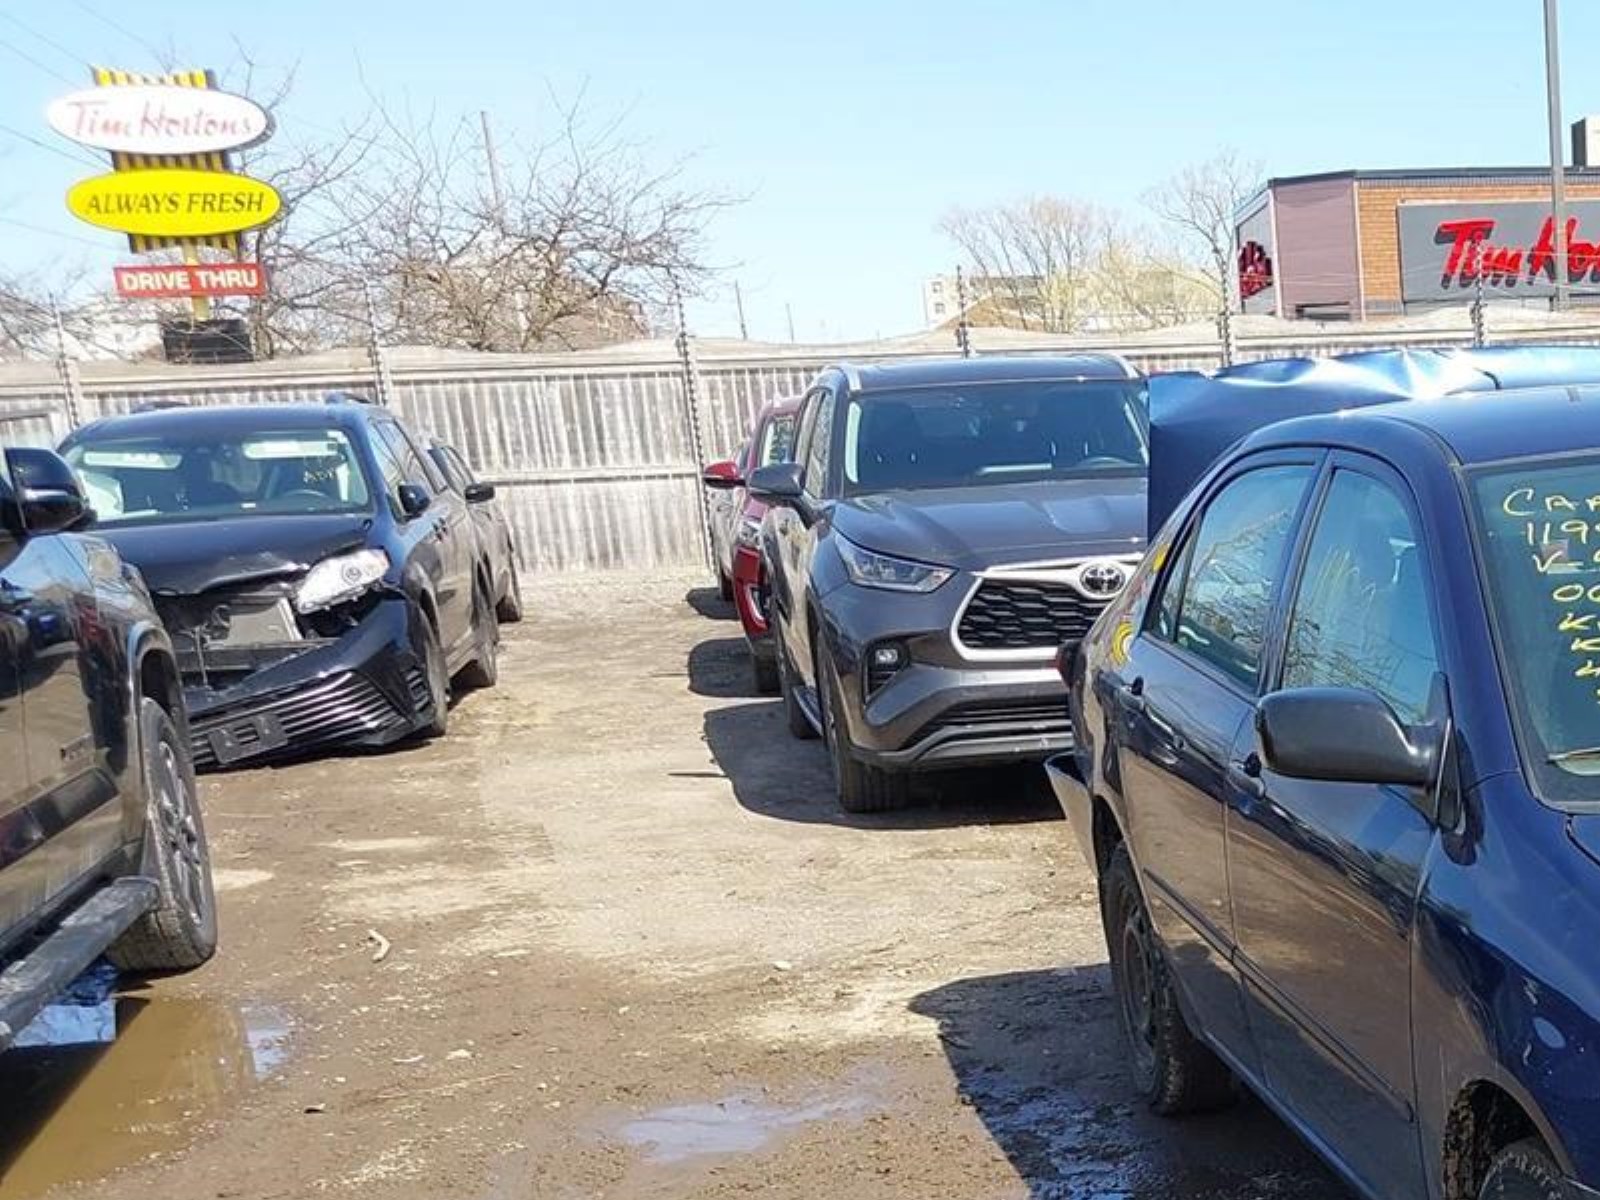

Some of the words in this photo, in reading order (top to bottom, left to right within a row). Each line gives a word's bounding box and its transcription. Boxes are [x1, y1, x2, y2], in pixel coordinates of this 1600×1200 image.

[66, 101, 130, 137] Tim
[142, 101, 251, 137] Hortons
[84, 192, 182, 215] ALWAYS
[186, 192, 265, 213] FRESH
[1439, 219, 1523, 278] Tim
[121, 270, 192, 290] DRIVE
[198, 269, 259, 288] THRU
